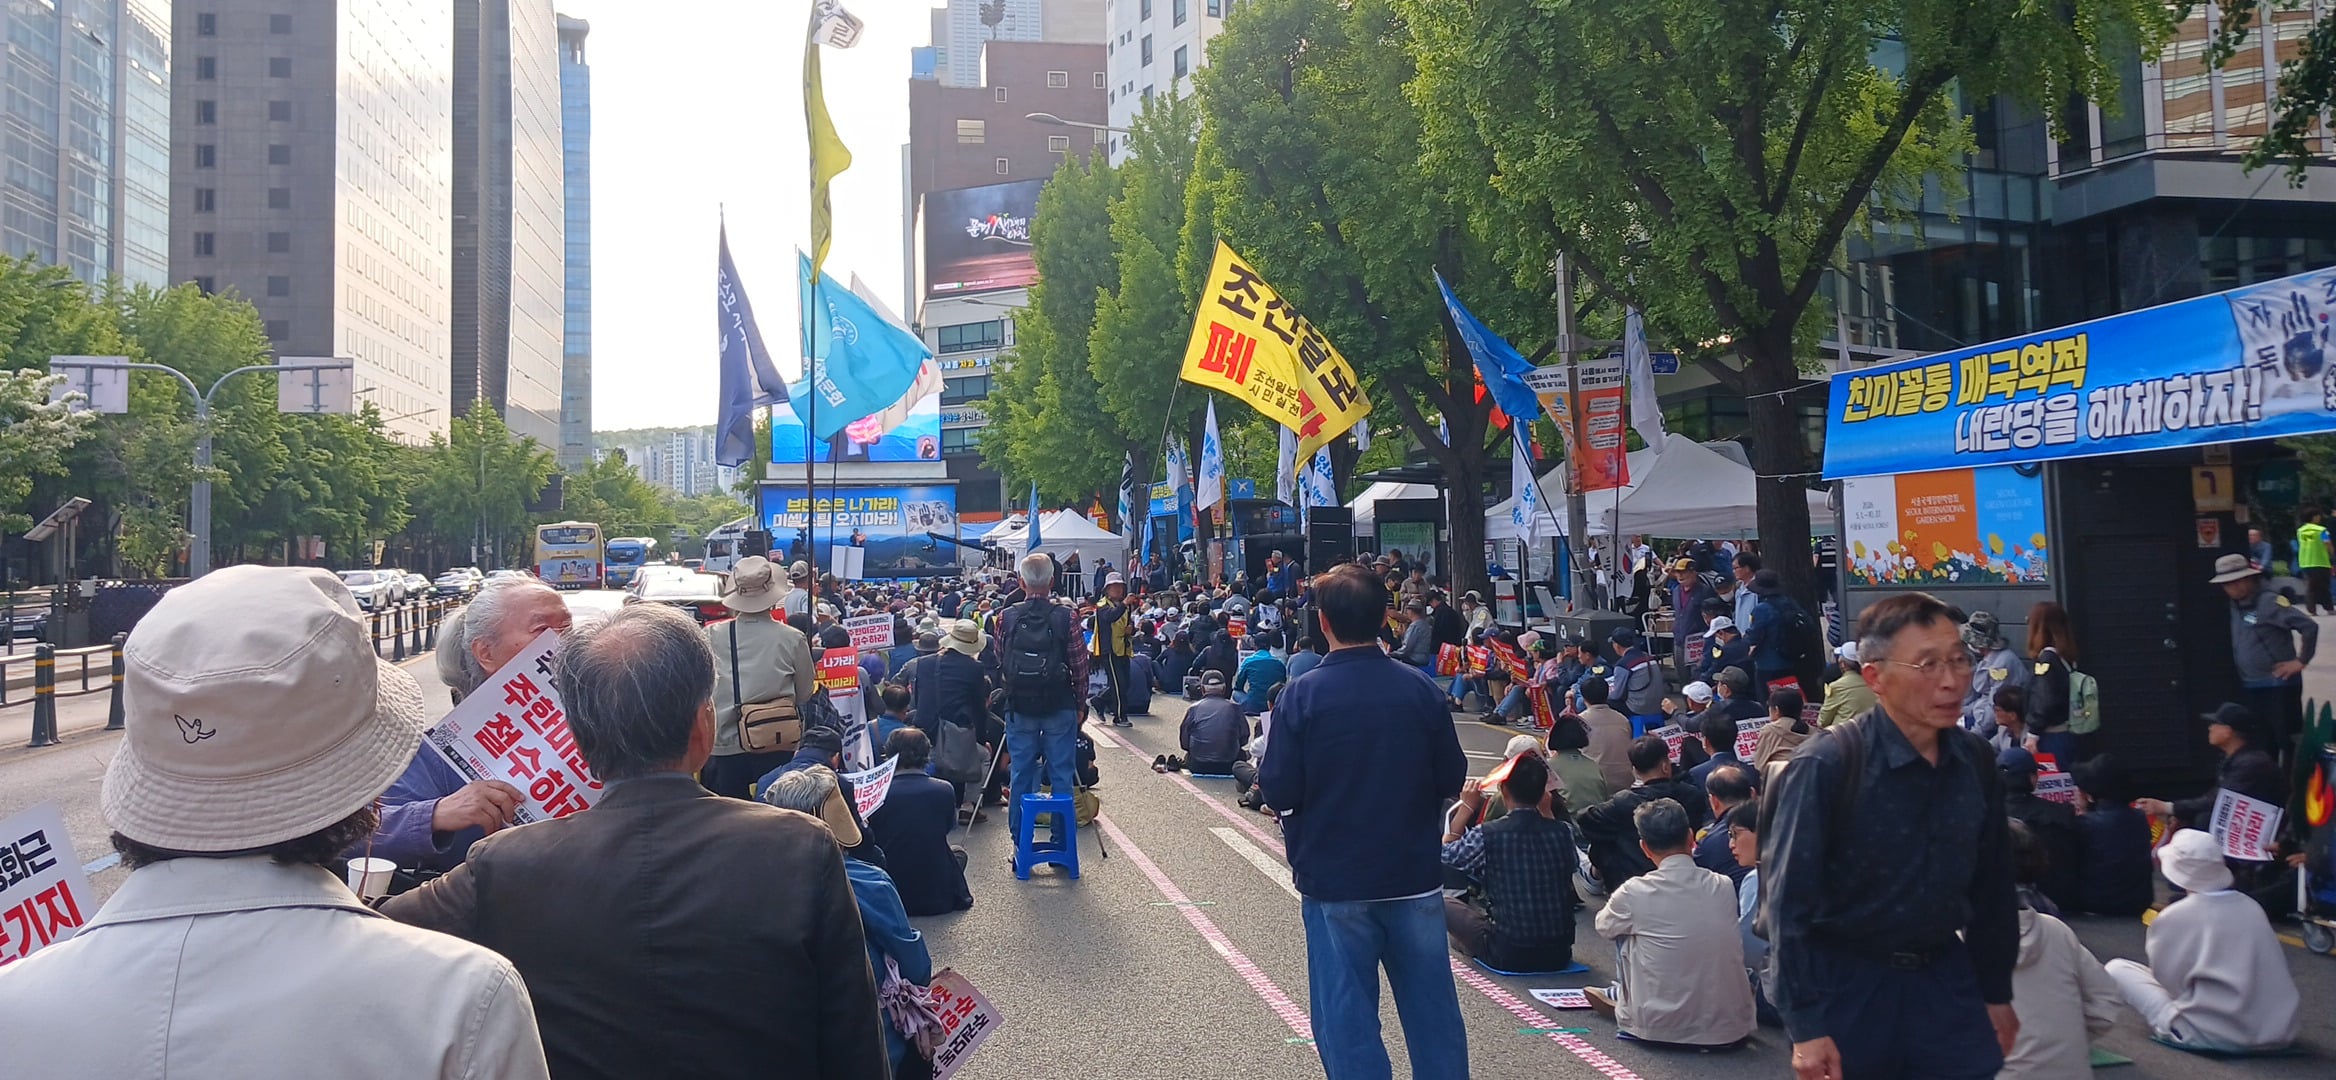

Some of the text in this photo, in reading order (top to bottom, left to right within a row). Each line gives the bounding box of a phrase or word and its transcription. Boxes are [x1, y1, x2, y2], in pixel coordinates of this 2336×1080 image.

[1198, 320, 1257, 386] 폐
[1217, 262, 1358, 413] 조선일보
[1842, 332, 2089, 424] 친미꼴통 매국역적
[1954, 364, 2262, 455] 내란당을 해체하자!
[834, 512, 898, 527] 오지마라!
[850, 497, 898, 512] 나가라!
[820, 676, 856, 689] 지마라!
[823, 655, 855, 668] 나가라!
[502, 672, 604, 790] 주한미군
[937, 1012, 990, 1068] 주권모독
